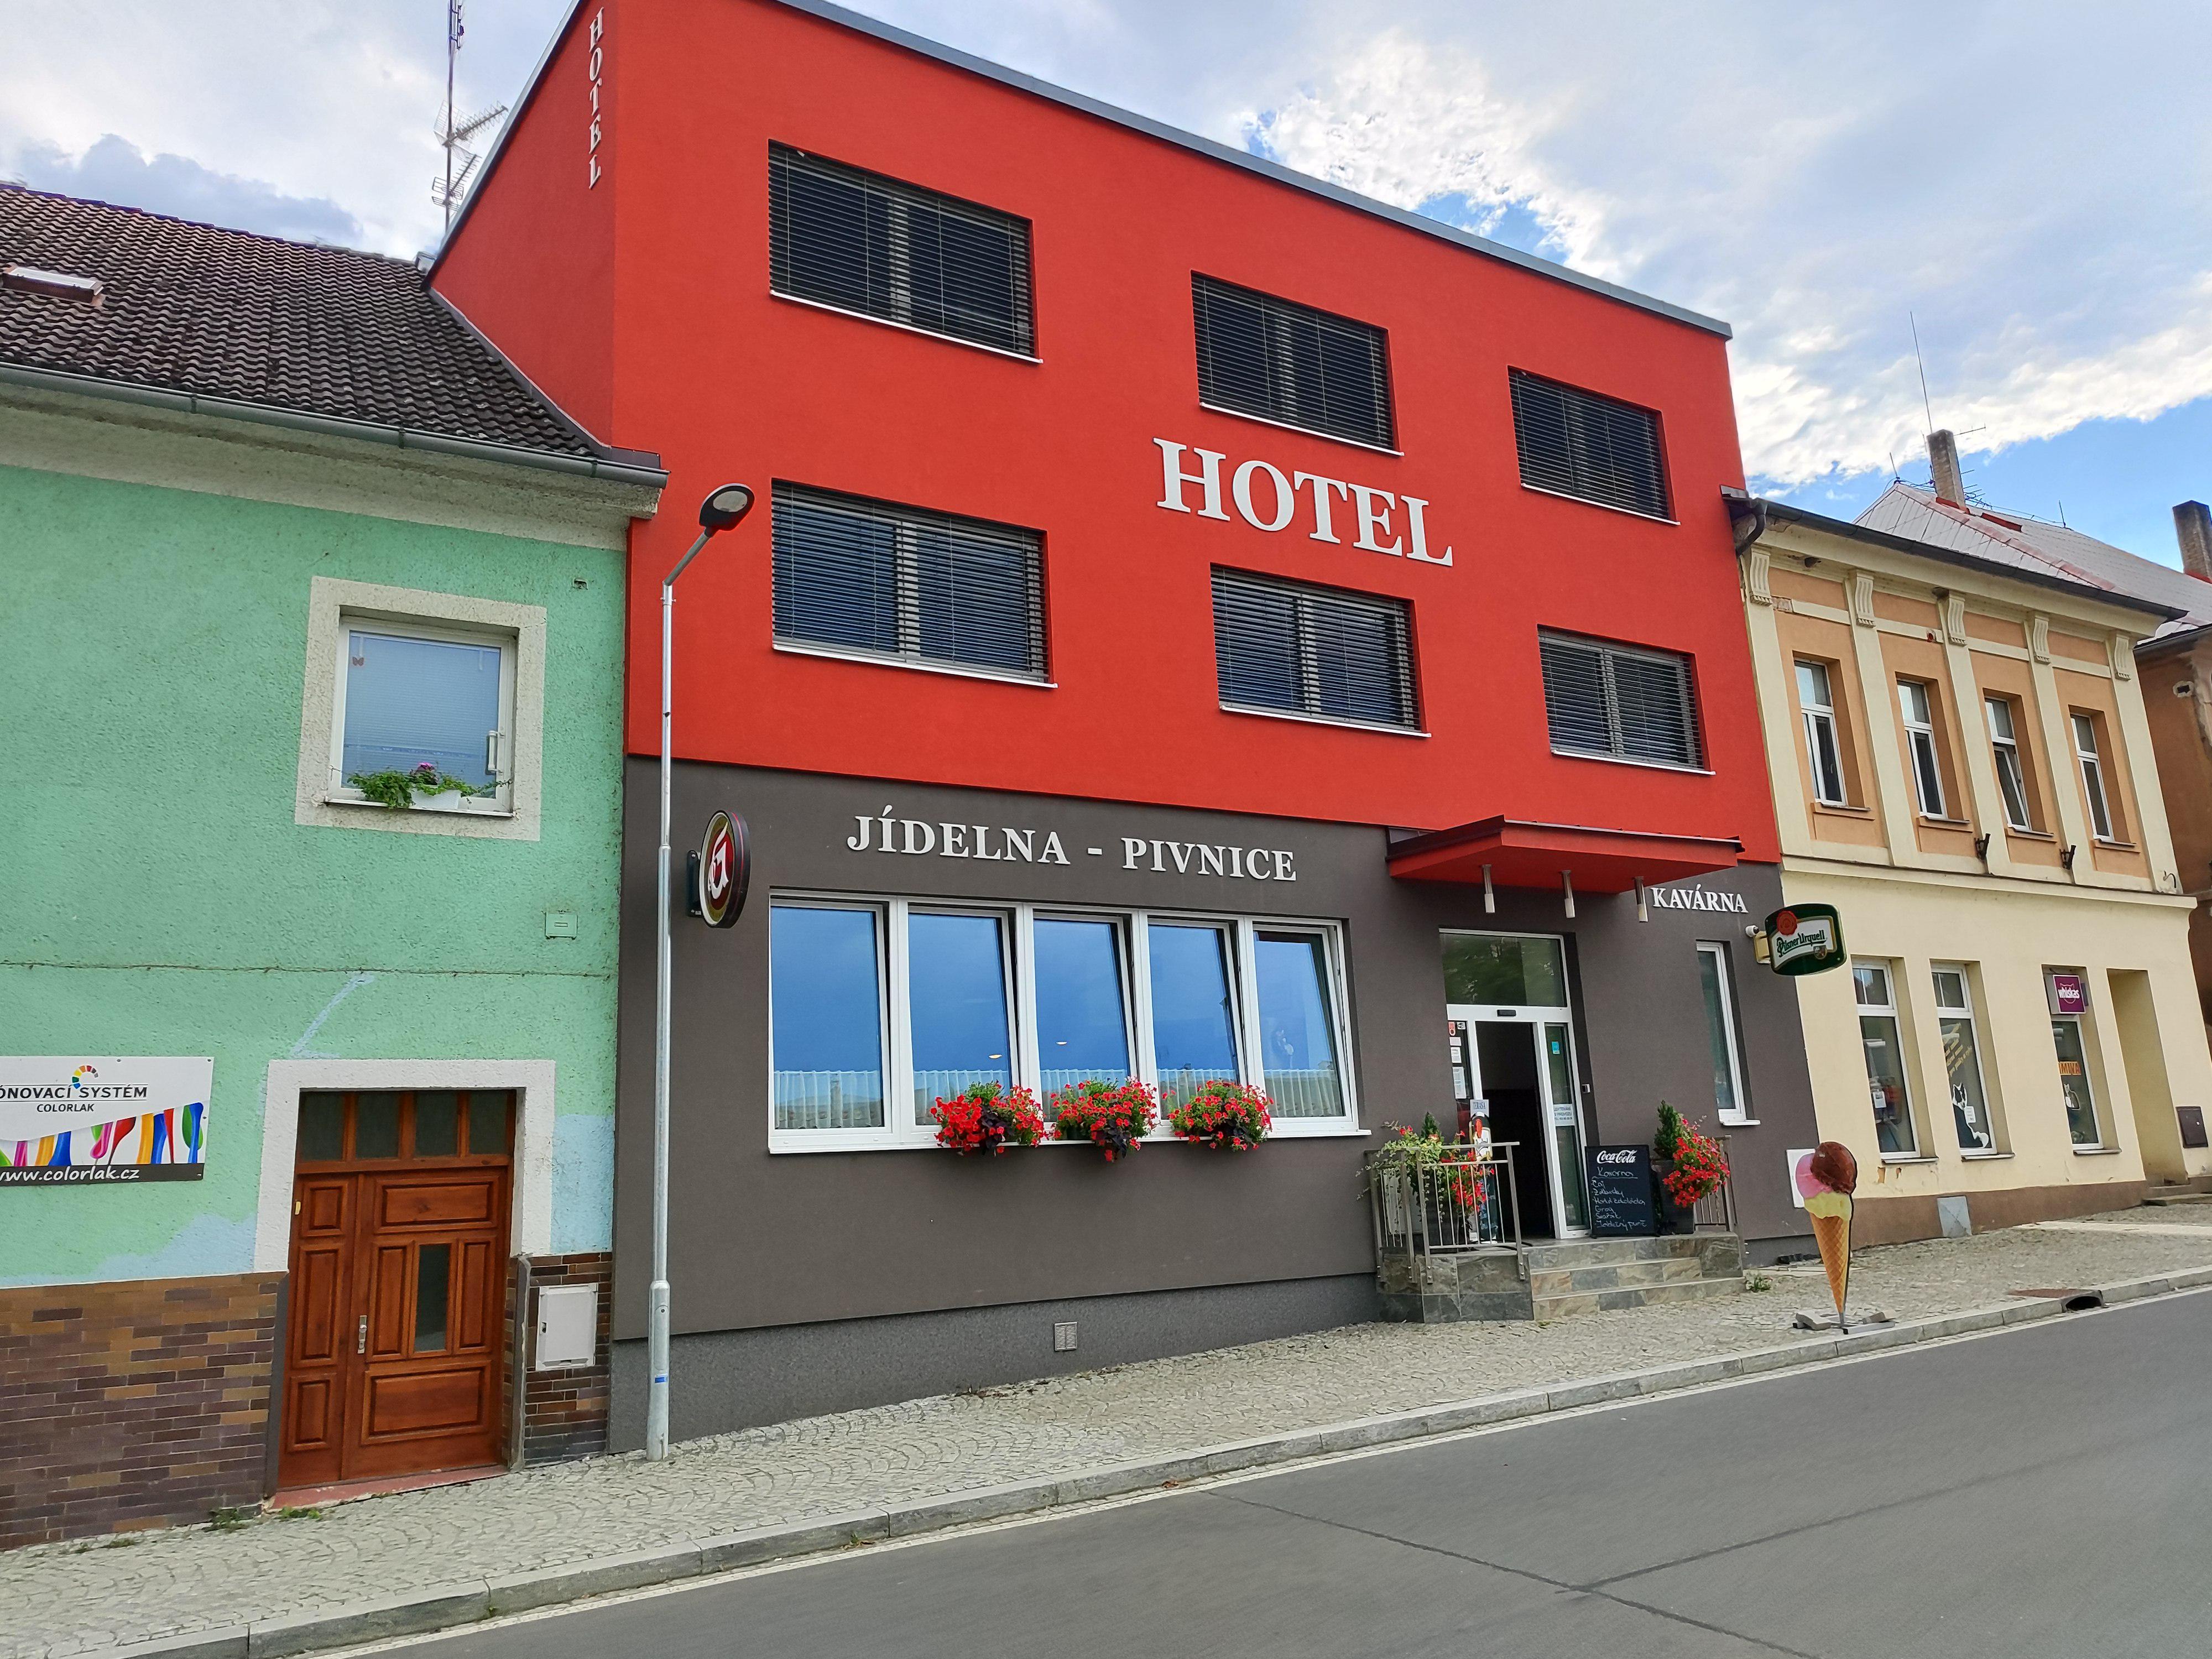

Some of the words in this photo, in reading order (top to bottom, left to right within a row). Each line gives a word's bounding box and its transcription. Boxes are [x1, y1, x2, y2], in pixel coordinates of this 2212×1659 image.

[588, 7, 604, 190] HOTEL
[1153, 437, 1453, 567] HOTEL
[847, 805, 1071, 865] JÍDELNA
[1120, 837, 1297, 881] PIVNICE
[1650, 883, 1749, 914] KAVÁRNA
[1776, 937, 1799, 957] Pilsner
[1797, 930, 1825, 947] Urquell
[2058, 987, 2080, 999] whiskas
[79, 1084, 148, 1098] SYSTÉM
[37, 1104, 94, 1113] COLORLAK
[1597, 1150, 1637, 1164] Coca-Cola
